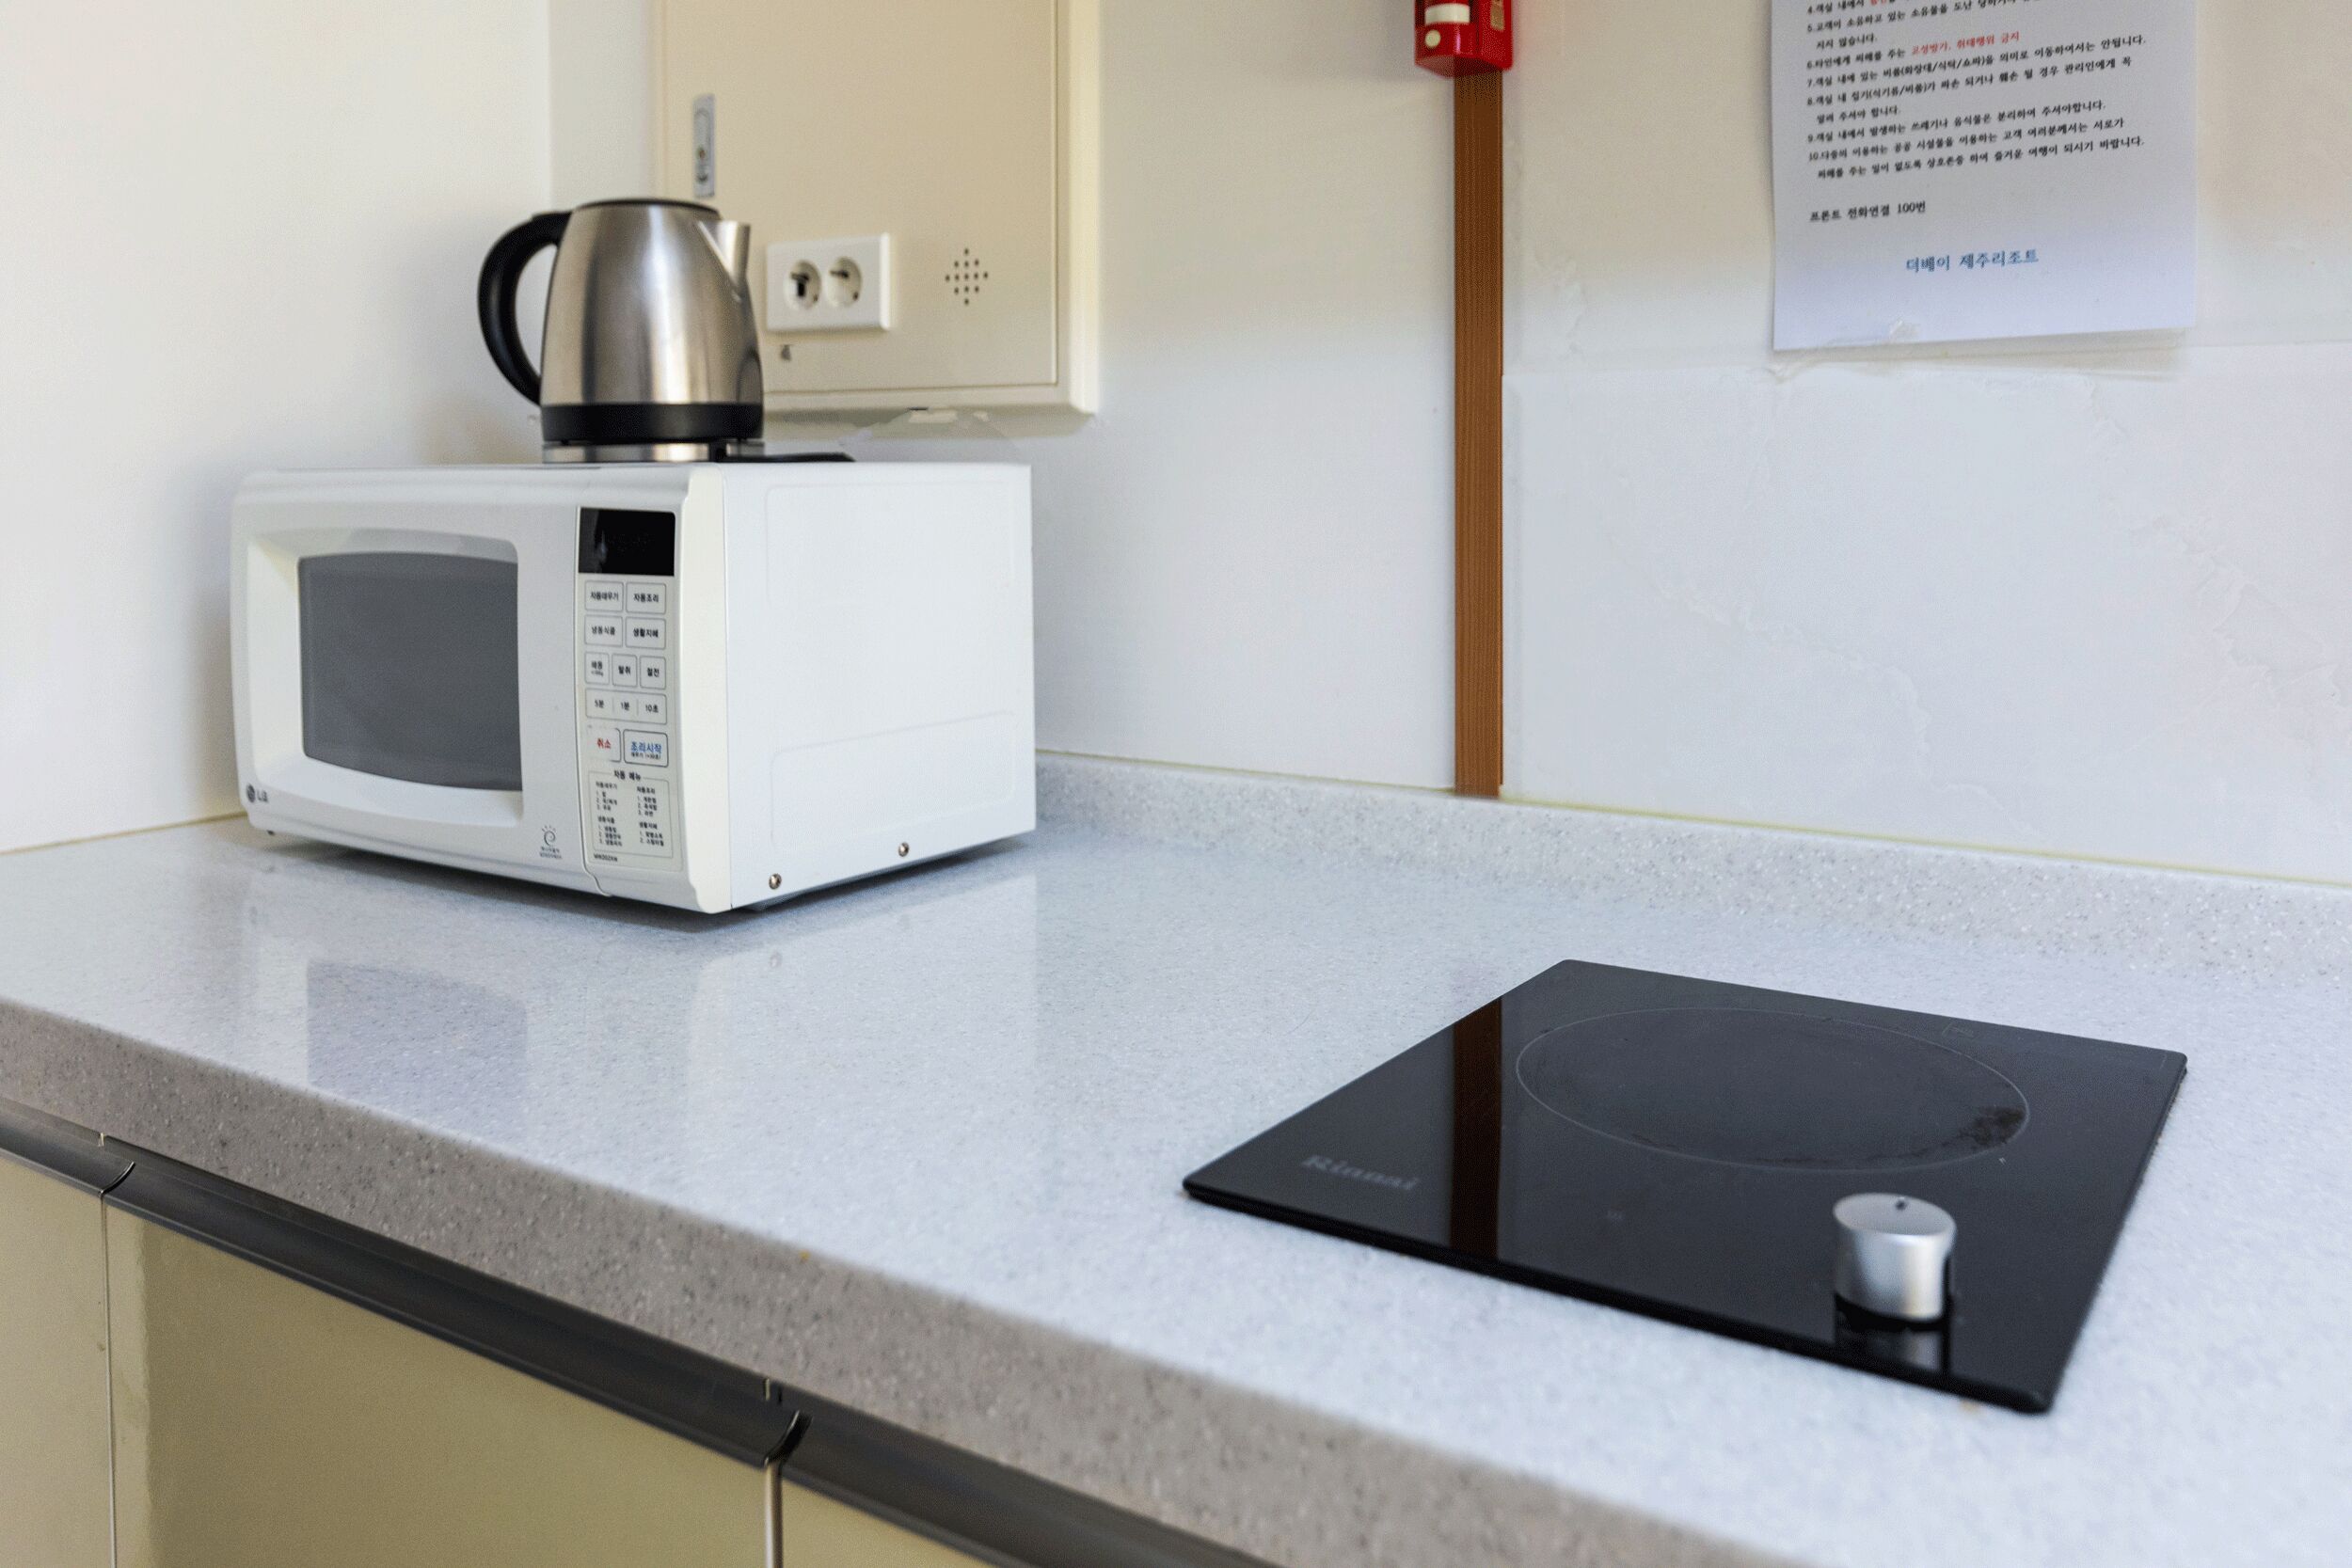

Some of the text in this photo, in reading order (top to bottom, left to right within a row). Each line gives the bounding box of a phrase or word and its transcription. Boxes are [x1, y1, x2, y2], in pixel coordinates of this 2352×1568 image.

[1807, 19, 1841, 32] 5.고객이
[1847, 14, 1883, 27] 소유하고
[1887, 10, 1906, 23] 있는
[1911, 4, 1948, 18] 소유물을
[1838, 33, 1878, 48] 않습니다.
[1806, 55, 1851, 70] 6.타인에게
[1855, 50, 1883, 63] 피해를
[1887, 47, 1906, 58] 주는
[1912, 41, 1951, 55] 고성방가,
[2001, 31, 2020, 44] 금지
[1807, 75, 1833, 87] 7.객실
[1837, 73, 1855, 84] 내에
[1860, 71, 1878, 83] 있는
[2034, 41, 2096, 58] 이동하여서는
[2101, 34, 2147, 50] 안됩니다.
[1807, 94, 1833, 106] 8.객실
[1837, 93, 1847, 103] 내
[1941, 78, 1960, 90] 파손
[1964, 73, 1994, 87] 되거나
[1998, 71, 2019, 83] 훼손
[2024, 68, 2033, 80] 될
[2039, 65, 2059, 78] 경우
[2064, 57, 2116, 75] 관리인에게
[2122, 56, 2132, 67] 꼭
[1817, 113, 1835, 124] 알려
[1870, 104, 1901, 118] 합니다.
[1807, 131, 1834, 143] 9.객실
[1838, 127, 1865, 140] 내에서
[1869, 123, 1906, 136] 발생하는
[1911, 118, 1948, 131] 쓰레기나
[1954, 113, 1992, 128] 음식물은
[1997, 107, 2036, 122] 분리하여
[1852, 144, 1889, 157] 이용하는
[1894, 140, 1912, 153] 공공
[1916, 136, 1954, 150] 시설물을
[1960, 132, 1997, 146] 이용하는
[2003, 128, 2023, 140] 고객
[2027, 121, 2089, 138] 여러분께서는
[2093, 117, 2124, 131] 서로가
[1818, 135, 2146, 180] 피해를 주는 일이 없도록 상호존중 하여 즐거운 여행이 되시기 바랍니다.
[1809, 199, 1927, 223] 프론트 전화연결 100번
[1905, 247, 2040, 274] 더베이 제주리조트
[633, 593, 660, 603] 자동조리
[591, 626, 616, 636] 냉동식품
[633, 628, 660, 639] 생활지혜
[595, 699, 605, 709] 5분
[620, 702, 630, 711] 1분
[644, 704, 660, 714] 10초
[596, 737, 612, 750] 취소
[630, 741, 662, 754] 조리시작
[614, 769, 642, 782] 자동 메뉴
